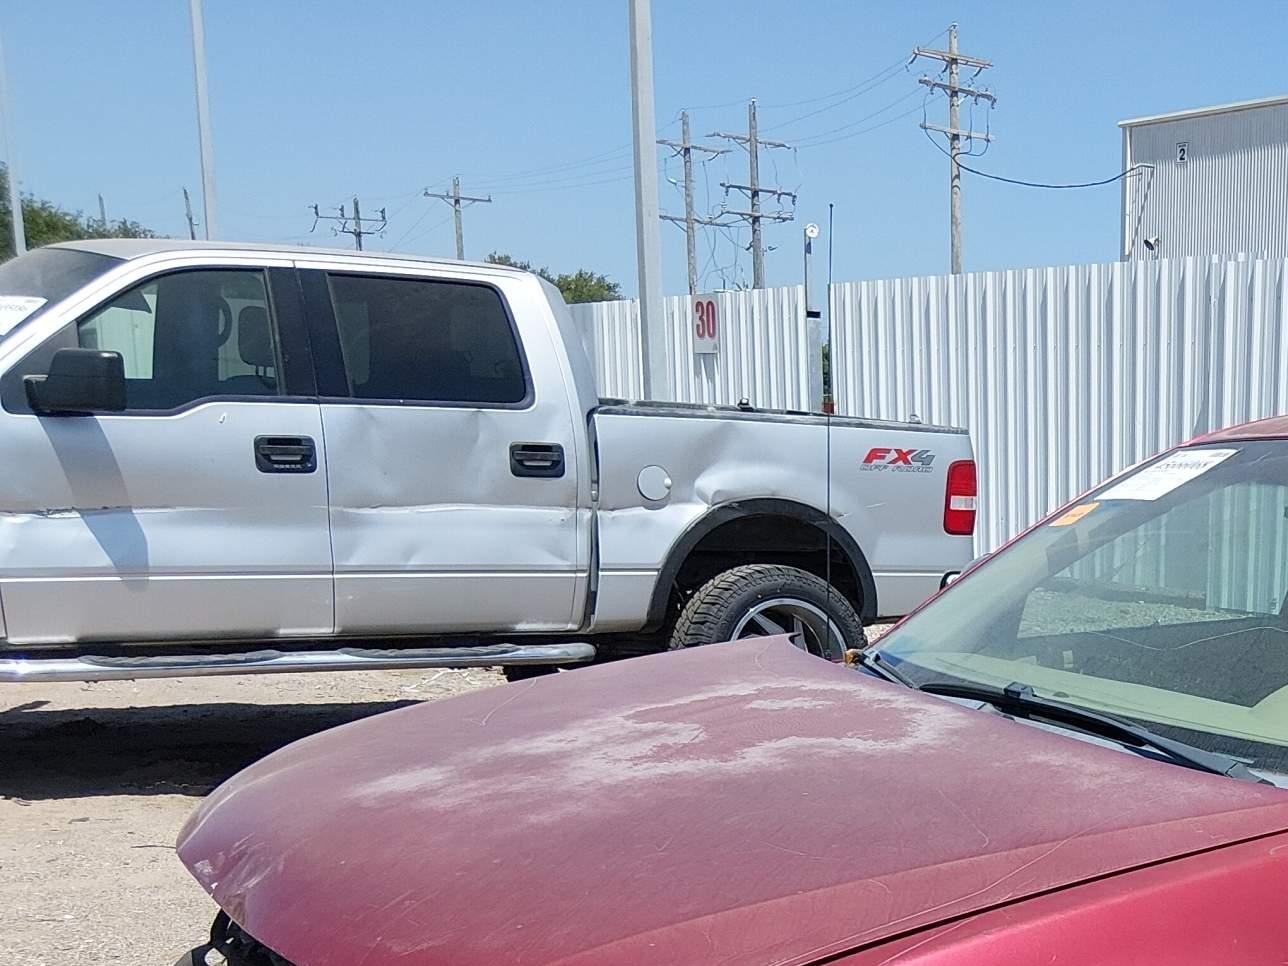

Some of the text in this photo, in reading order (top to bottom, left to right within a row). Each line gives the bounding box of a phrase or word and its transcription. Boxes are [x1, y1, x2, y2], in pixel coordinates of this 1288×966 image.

[1179, 148, 1186, 161] 2
[695, 300, 717, 339] 30
[863, 447, 936, 466] FX4
